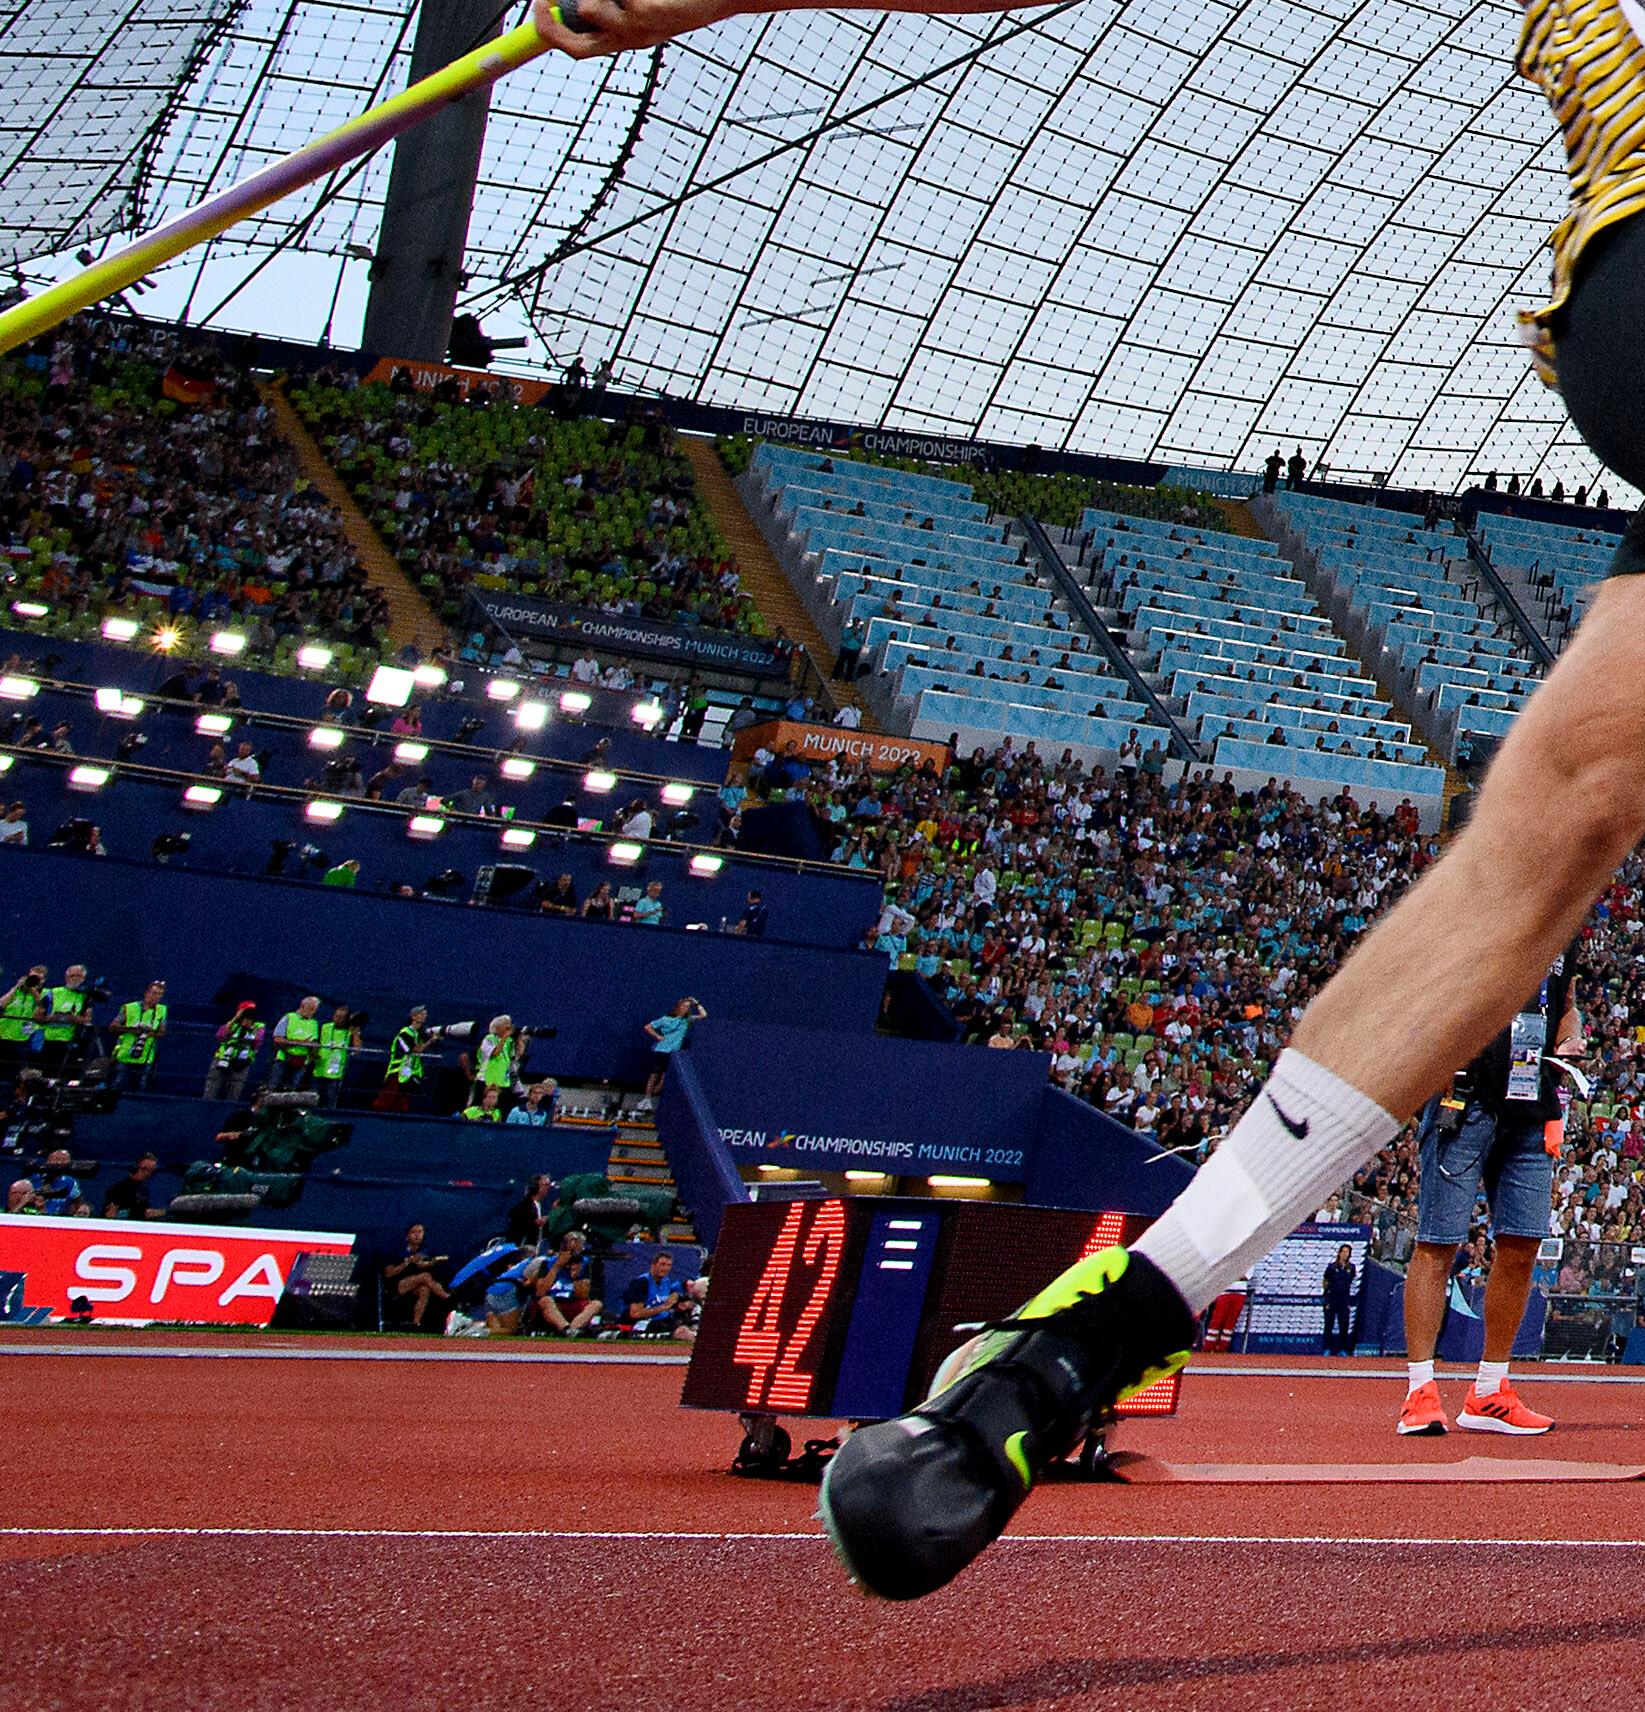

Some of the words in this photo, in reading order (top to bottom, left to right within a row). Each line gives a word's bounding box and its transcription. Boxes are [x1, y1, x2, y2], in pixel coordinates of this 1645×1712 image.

[743, 417, 833, 444] EUROPEAN
[864, 434, 988, 462] CHAMPIONSHIPS
[486, 603, 558, 628] EUROPEAN
[581, 621, 682, 649] CHAMPIONSHIPS
[685, 639, 740, 660] MUNICH
[741, 648, 775, 666] 2022
[803, 732, 874, 757] MUNICH
[795, 1134, 914, 1159] CHAMPIONSHIPS
[917, 1143, 981, 1163] MUNICH
[986, 1147, 1024, 1166] 2022
